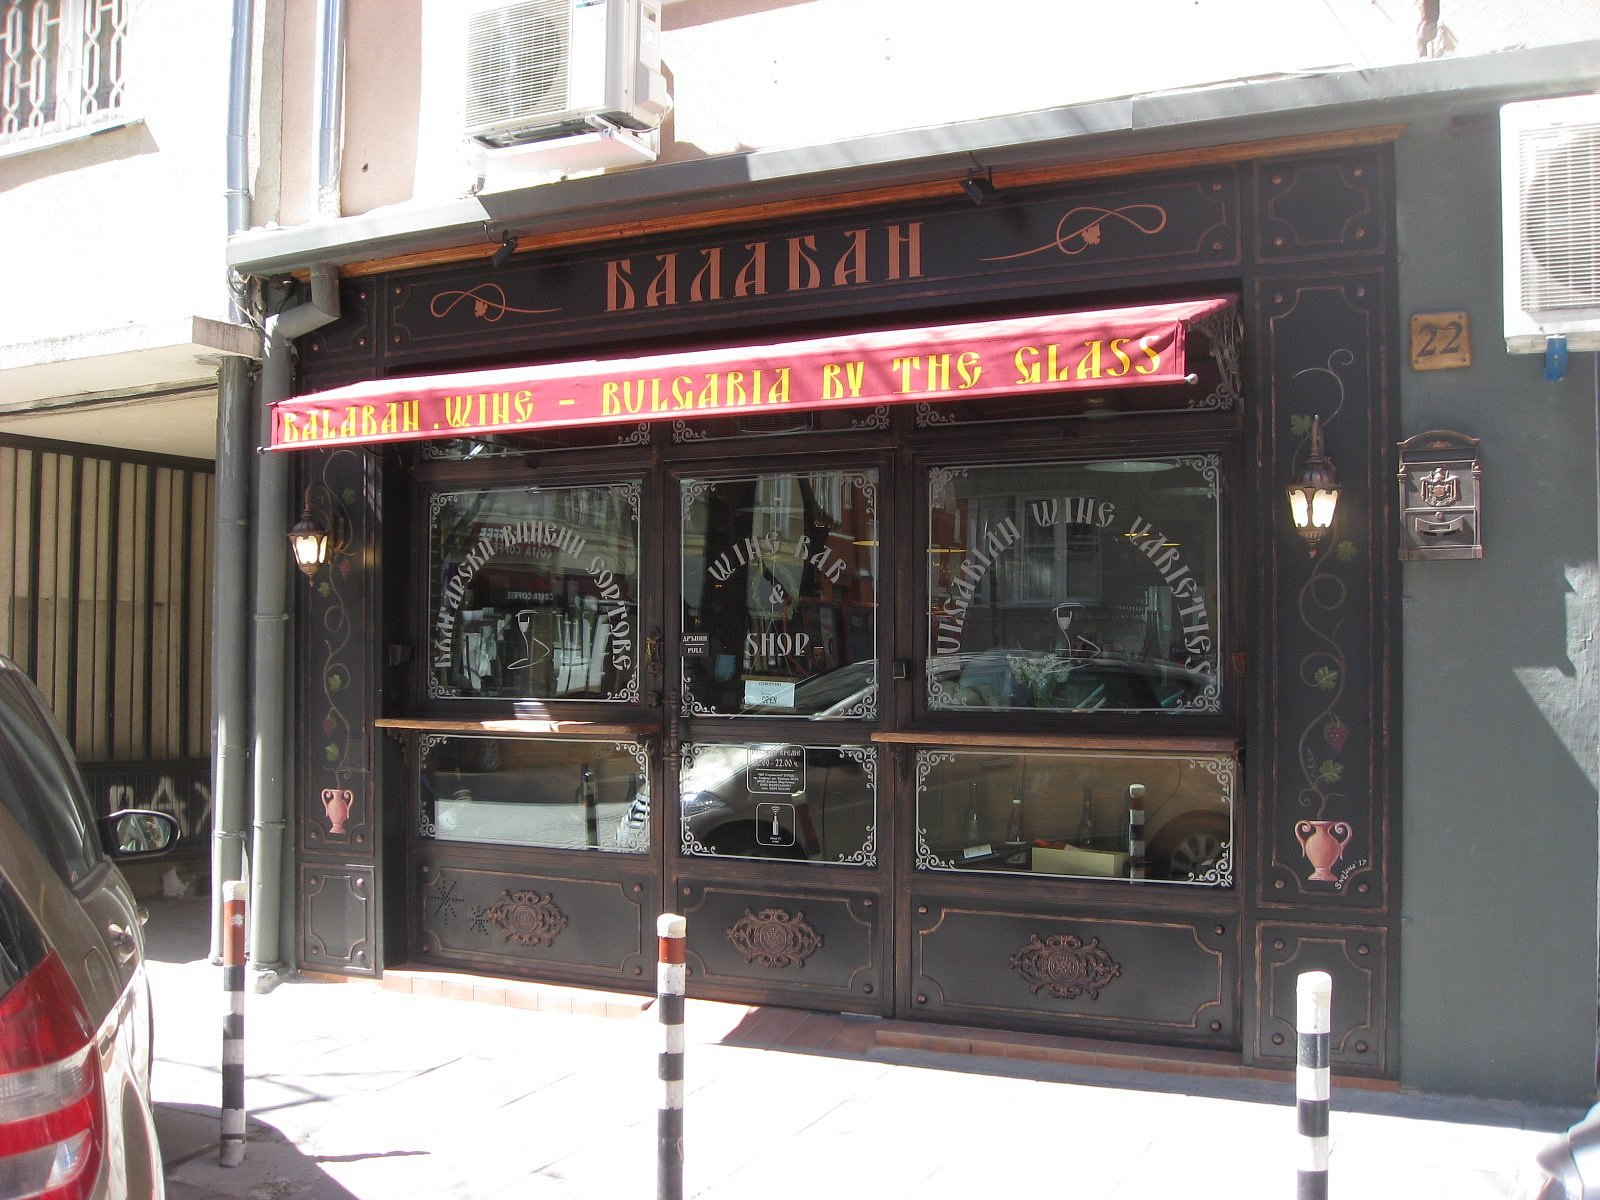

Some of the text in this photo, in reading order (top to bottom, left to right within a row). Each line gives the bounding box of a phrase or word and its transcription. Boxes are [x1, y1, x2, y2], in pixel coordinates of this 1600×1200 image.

[604, 222, 923, 312] БАЛАБАН
[1418, 320, 1463, 358] 22
[282, 399, 420, 443] BALABAN
[601, 367, 791, 416] BULGARIA
[820, 361, 864, 400] BY
[892, 351, 982, 394] THE
[1015, 335, 1161, 385] GLASS
[707, 531, 848, 584] WINE BAR
[1031, 497, 1116, 528] WINE
[1128, 515, 1212, 677] VARIETIES
[502, 520, 587, 560] ВИНЕНИ
[586, 555, 632, 671] СОРТОВЕ
[769, 583, 785, 605] &
[746, 632, 811, 657] SHOP
